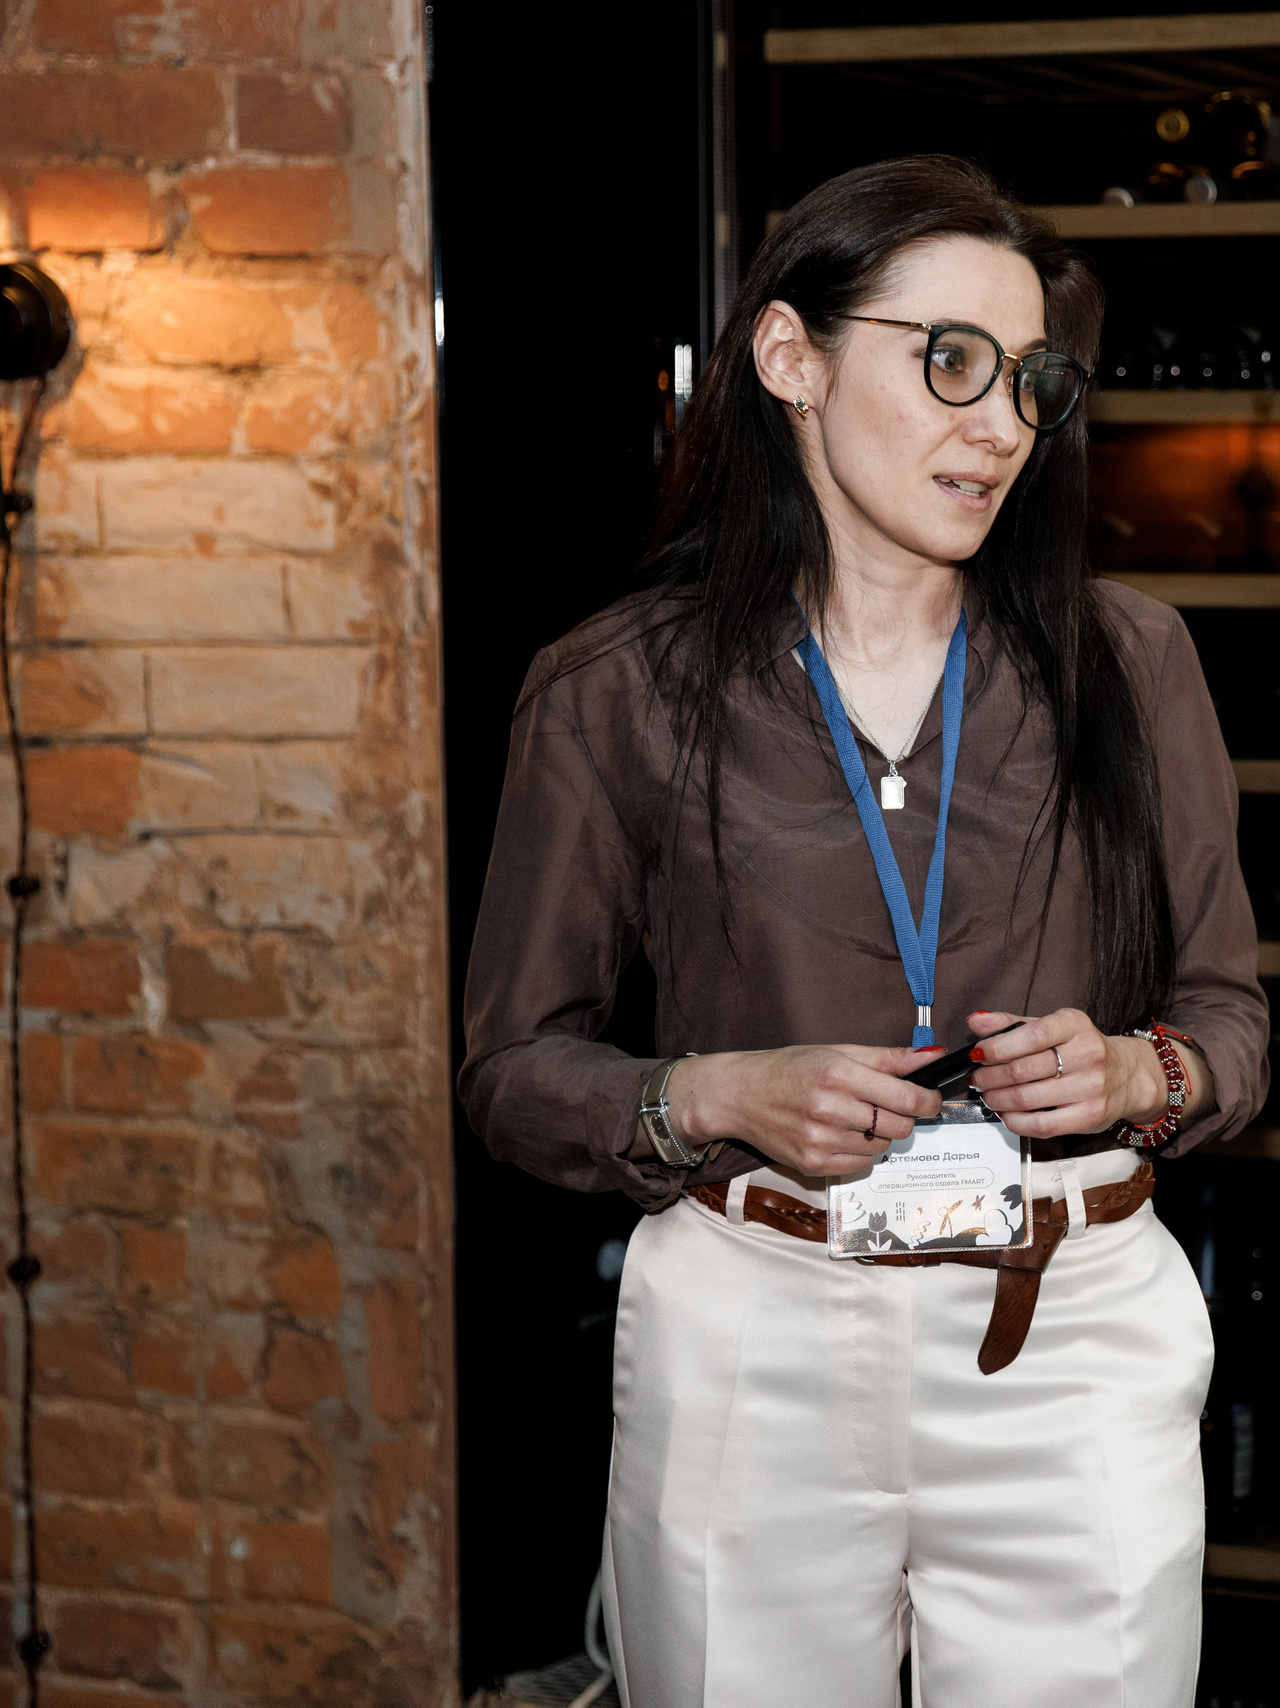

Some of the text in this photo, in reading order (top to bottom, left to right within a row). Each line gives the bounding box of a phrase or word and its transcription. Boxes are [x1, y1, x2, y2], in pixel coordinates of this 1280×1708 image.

[881, 1152, 980, 1165] Артемова Дарья
[906, 1173, 956, 1181] Руководитель
[878, 1181, 934, 1190] операционного
[960, 1178, 985, 1186] FMART
